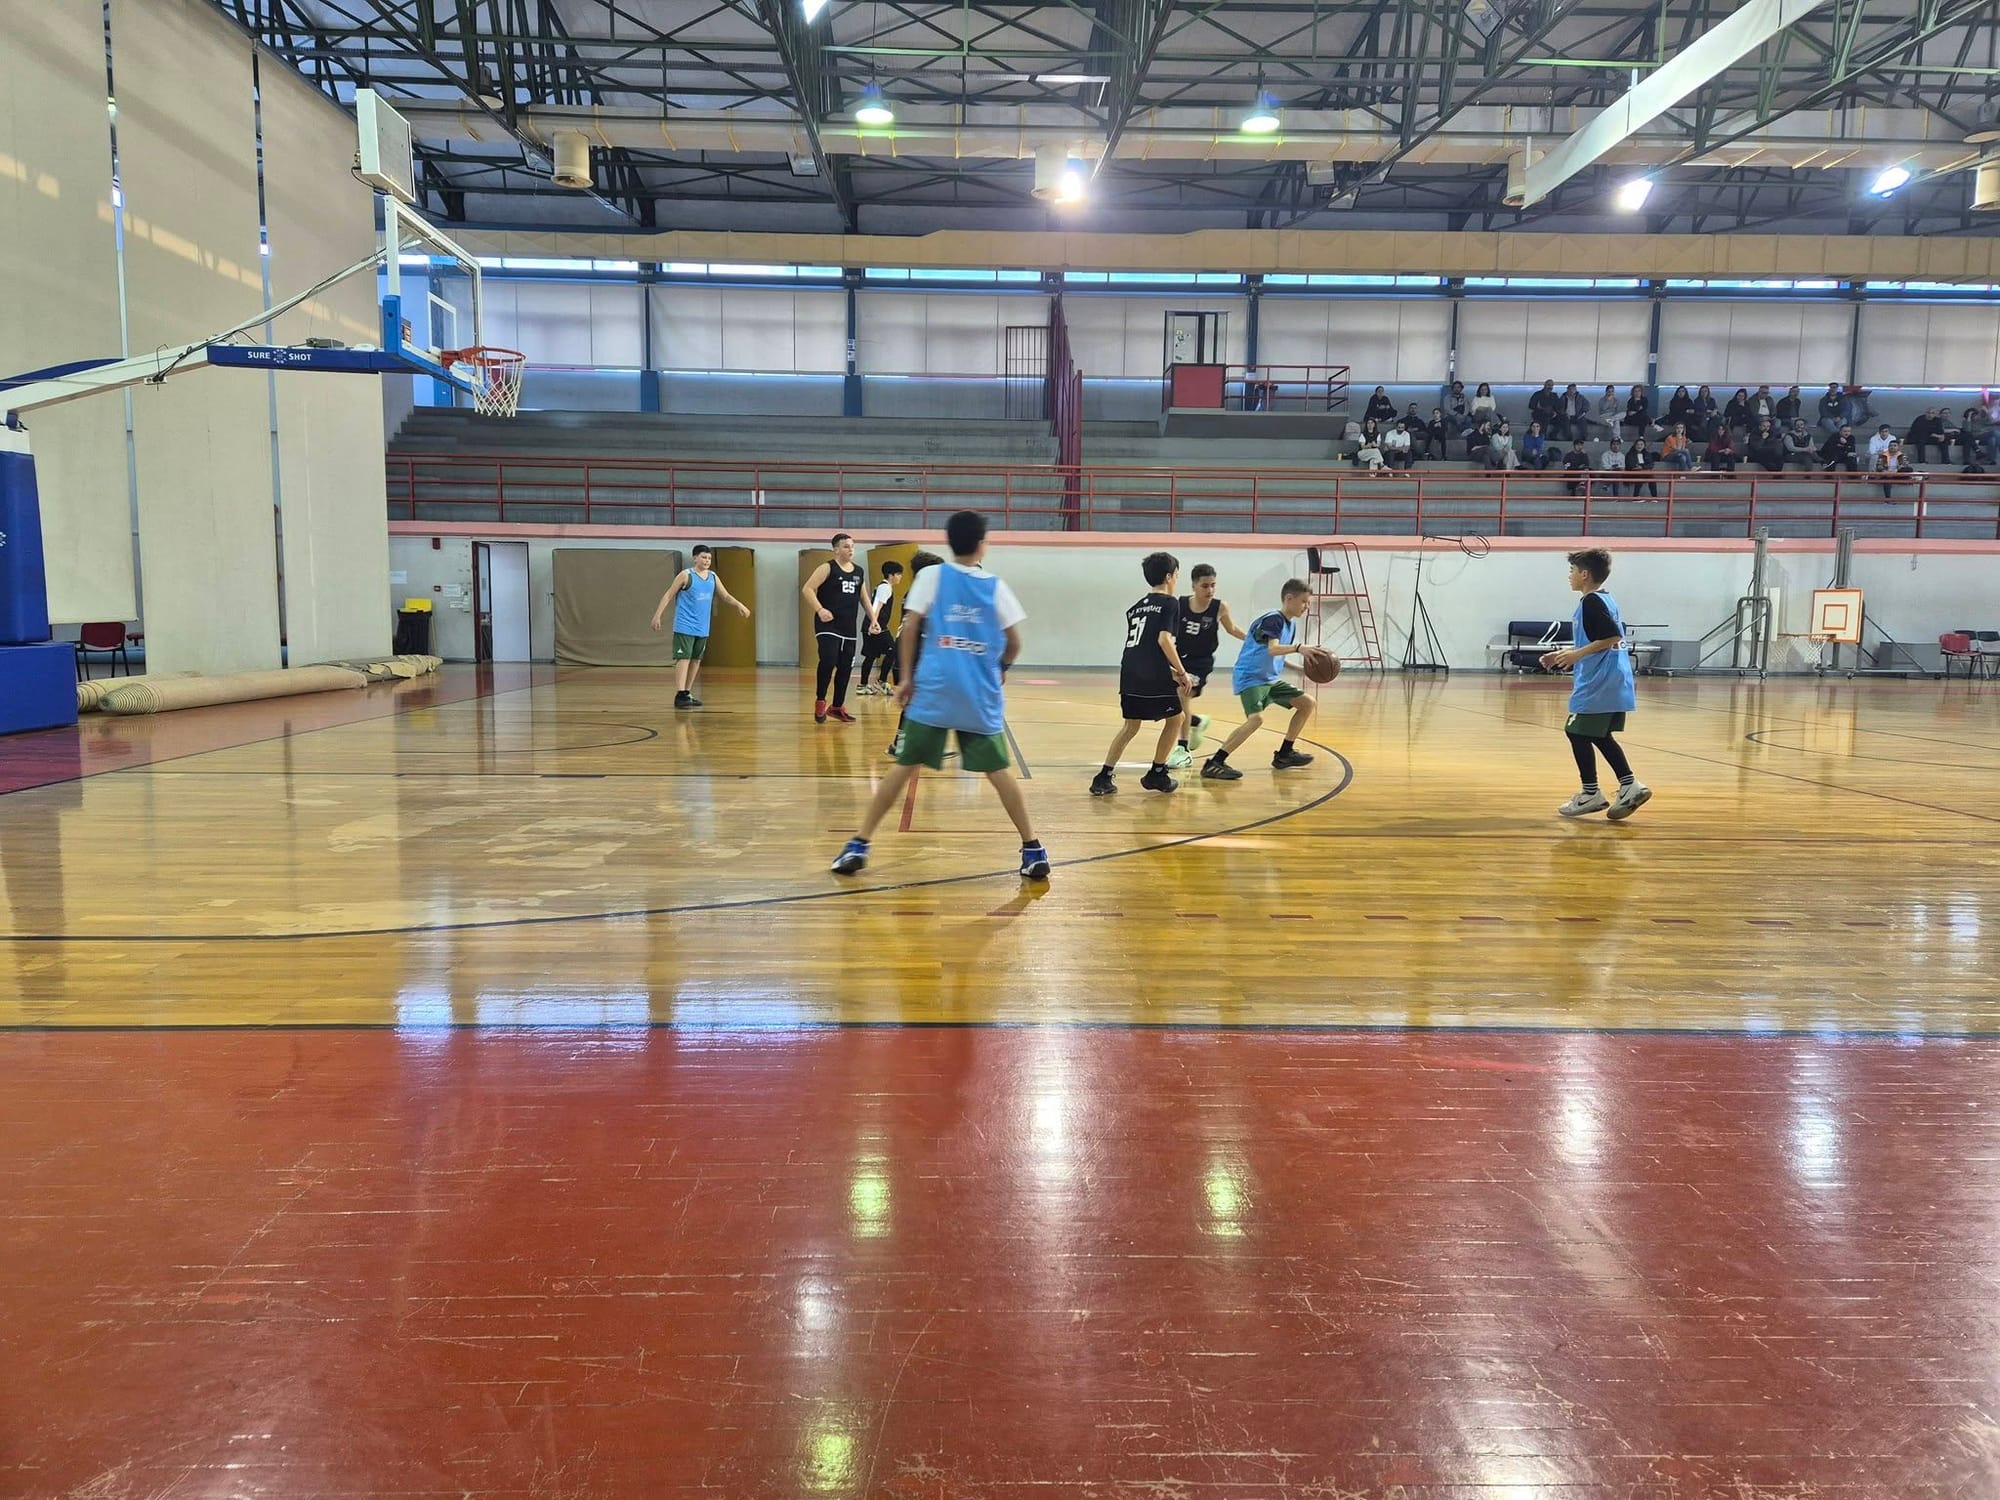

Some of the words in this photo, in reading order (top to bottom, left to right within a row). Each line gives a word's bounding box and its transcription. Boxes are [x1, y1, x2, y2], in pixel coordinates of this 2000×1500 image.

[247, 351, 271, 360] SURE
[288, 353, 312, 361] SHOT
[842, 580, 856, 594] 25
[1126, 616, 1147, 648] 31
[1185, 621, 1201, 636] 33
